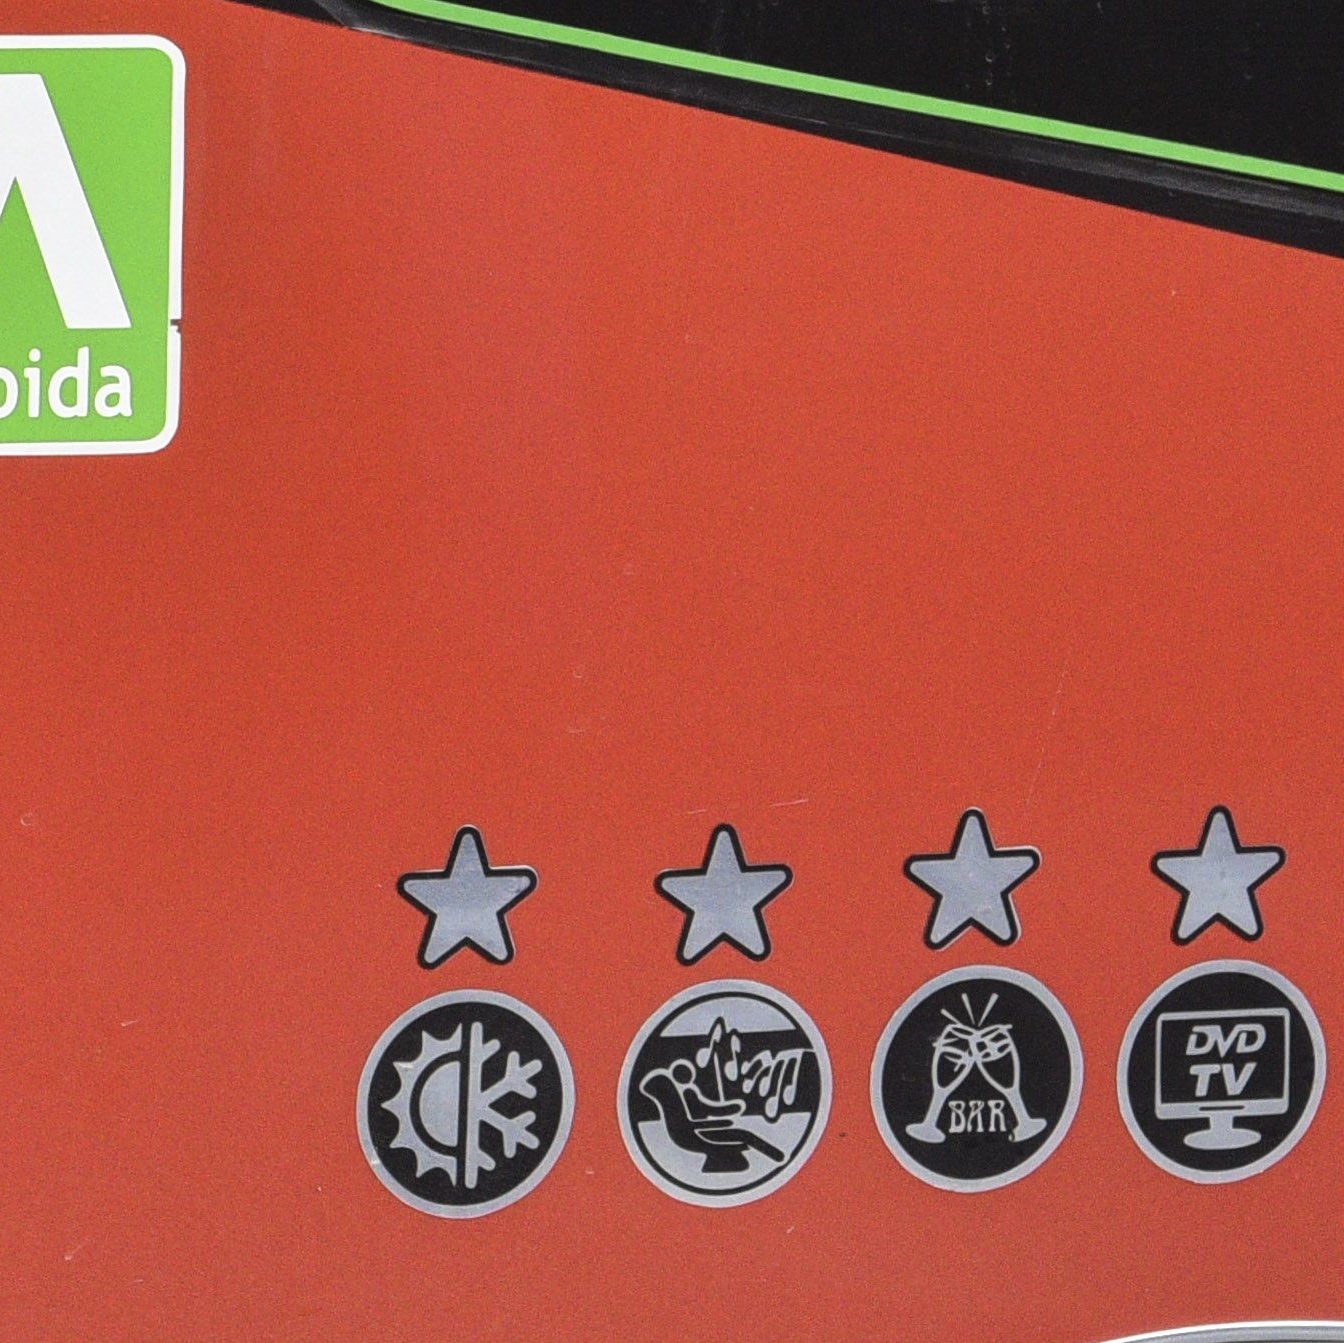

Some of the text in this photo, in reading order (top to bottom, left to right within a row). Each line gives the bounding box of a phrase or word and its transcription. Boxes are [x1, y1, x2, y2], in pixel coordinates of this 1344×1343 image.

[1185, 1024, 1266, 1058] DVD
[1190, 1061, 1255, 1098] TV
[949, 1099, 1007, 1133] BAR
